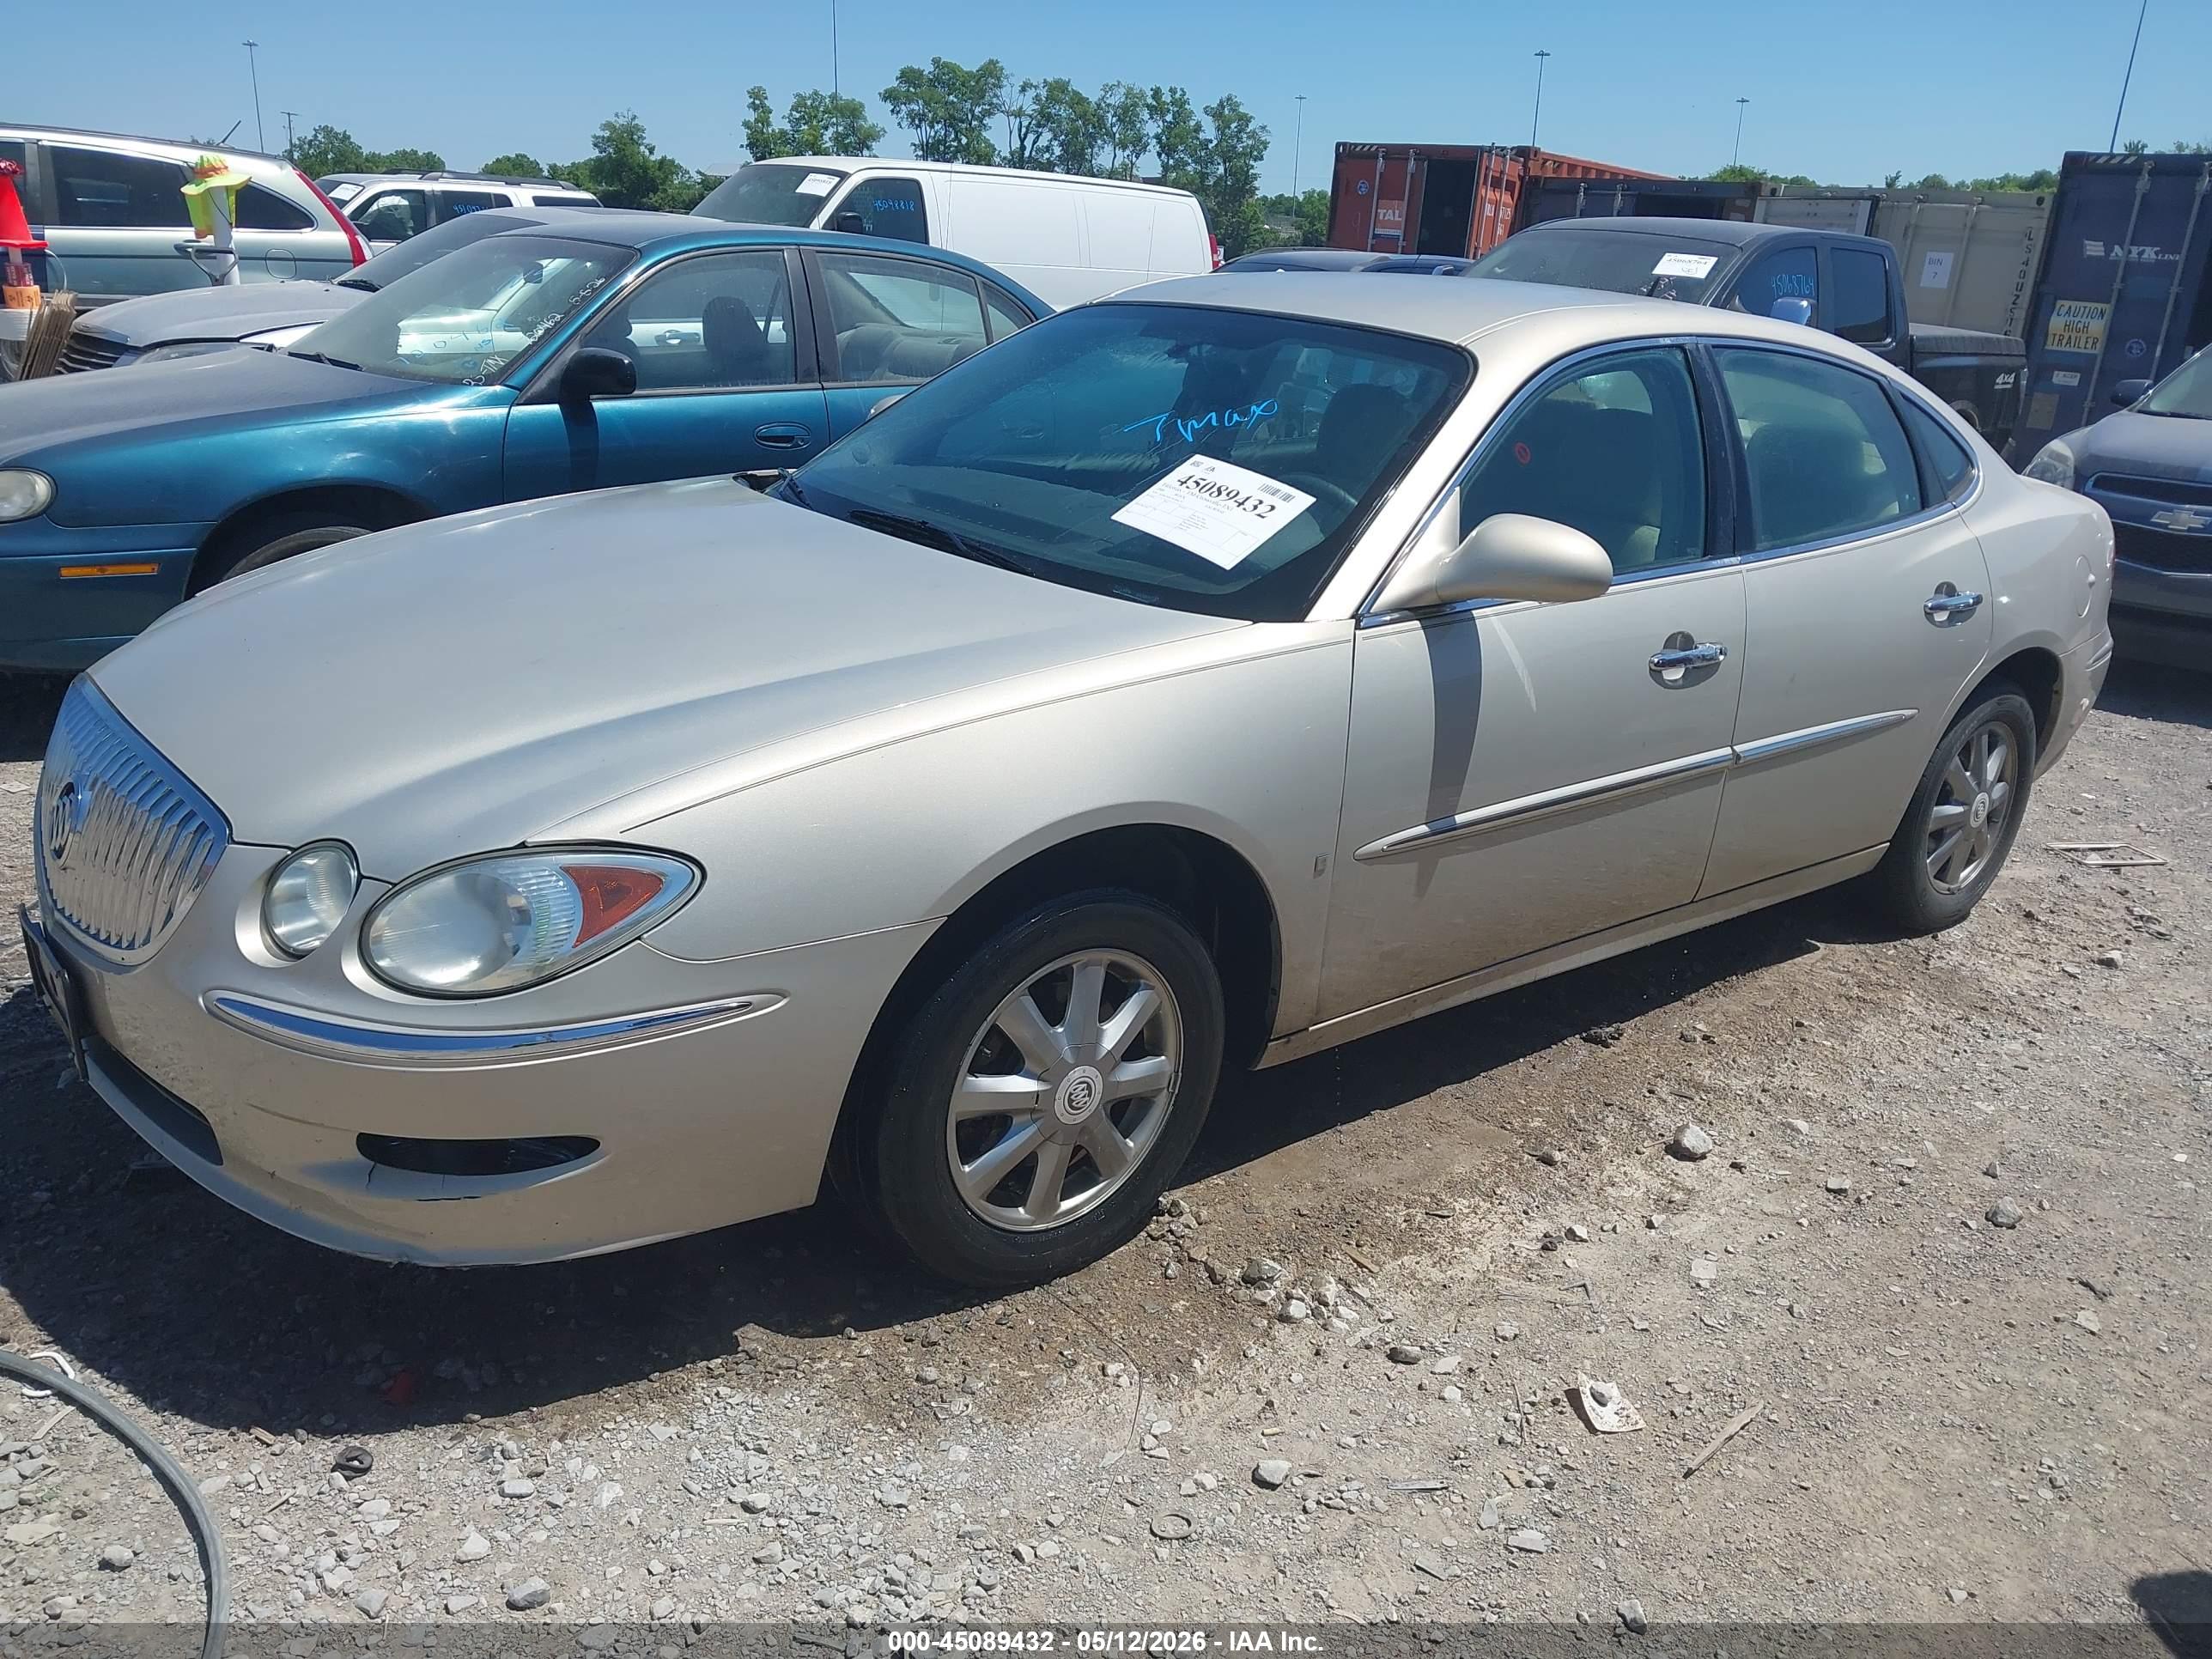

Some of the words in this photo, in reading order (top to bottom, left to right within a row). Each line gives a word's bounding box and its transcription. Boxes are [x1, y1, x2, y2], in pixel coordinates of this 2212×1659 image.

[2109, 244, 2161, 259] NYK
[1928, 257, 1944, 267] BIN
[2057, 304, 2107, 320] CAUTION
[2063, 319, 2090, 335] HIGH
[2051, 333, 2100, 351] TRAILER
[1176, 474, 1277, 520] 45089432
